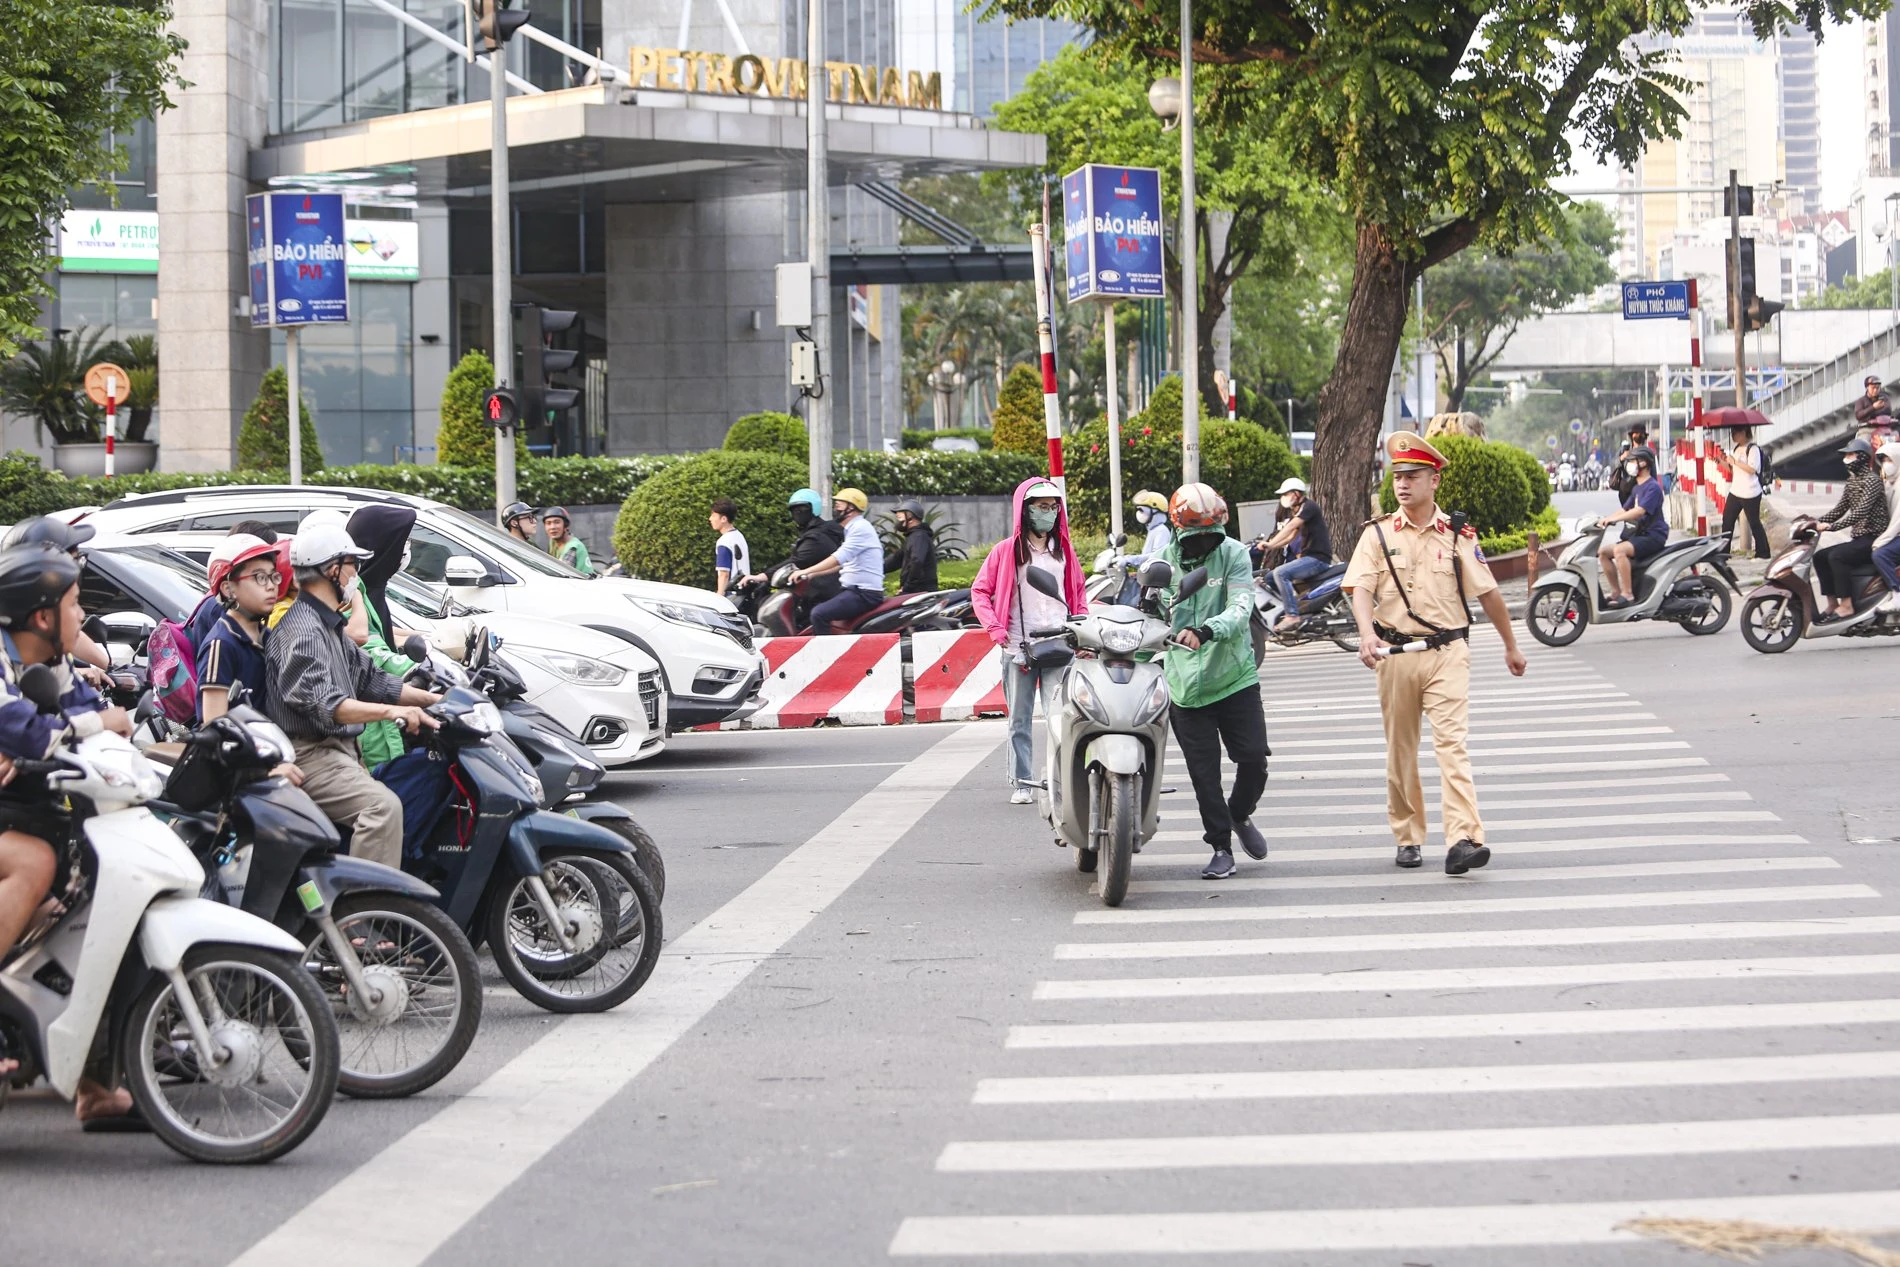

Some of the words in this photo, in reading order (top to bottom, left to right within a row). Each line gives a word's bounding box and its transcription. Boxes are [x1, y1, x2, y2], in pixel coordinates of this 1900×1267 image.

[629, 46, 942, 110] PETROVITNAM
[120, 225, 158, 239] PETRO
[1095, 211, 1124, 234] BẢO
[1127, 211, 1159, 236] HIỂM
[274, 238, 306, 260] BẢO
[309, 235, 343, 260] HIỂM
[1117, 237, 1139, 254] PVI
[298, 264, 322, 280] PVI
[1646, 285, 1665, 297] PHỐ
[1649, 297, 1664, 313] THÚC
[1665, 296, 1684, 312] KHÁNG
